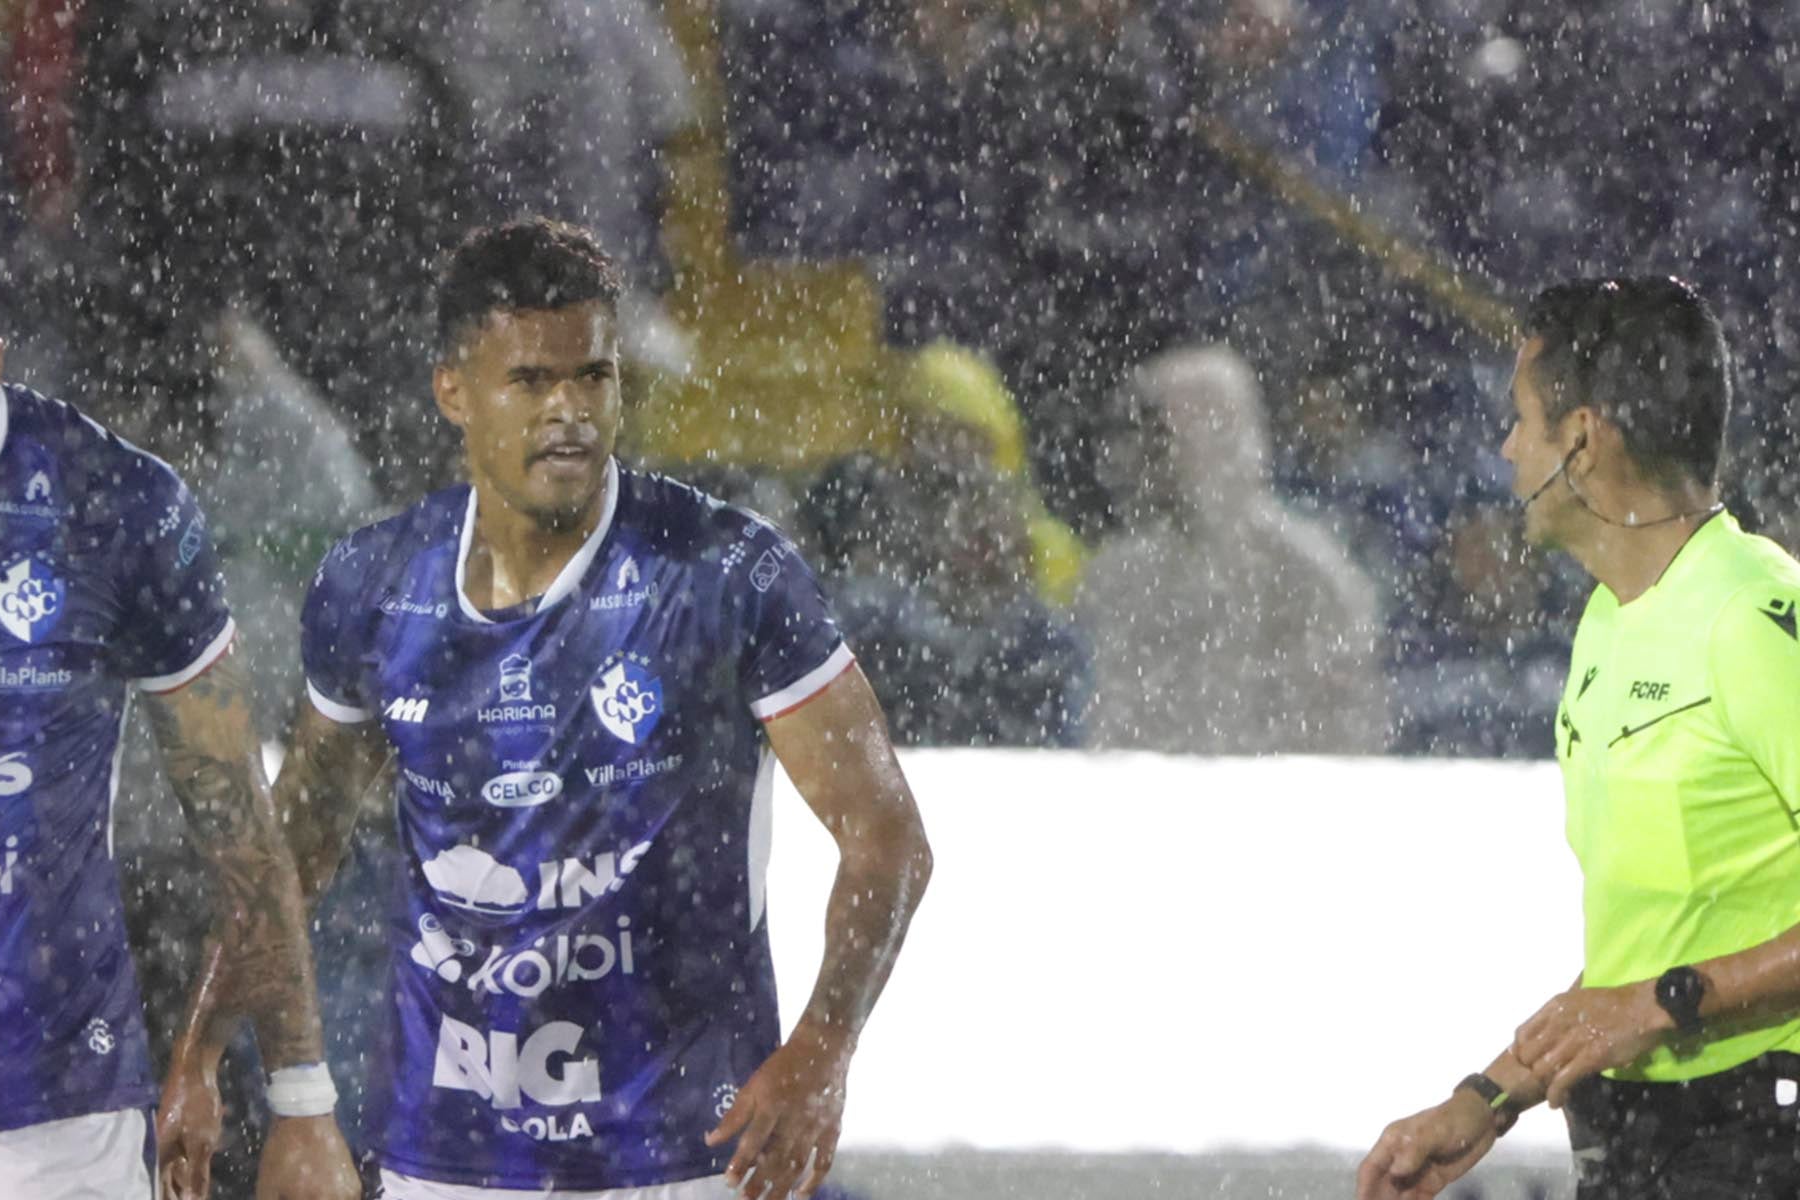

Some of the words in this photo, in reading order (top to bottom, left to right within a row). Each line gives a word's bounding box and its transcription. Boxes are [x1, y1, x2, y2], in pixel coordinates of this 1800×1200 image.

[1629, 681, 1670, 701] FCRF
[478, 704, 556, 722] HARIANA
[584, 755, 683, 785] VillaPlants
[489, 780, 554, 800] CELCO
[433, 1013, 601, 1108] BIG
